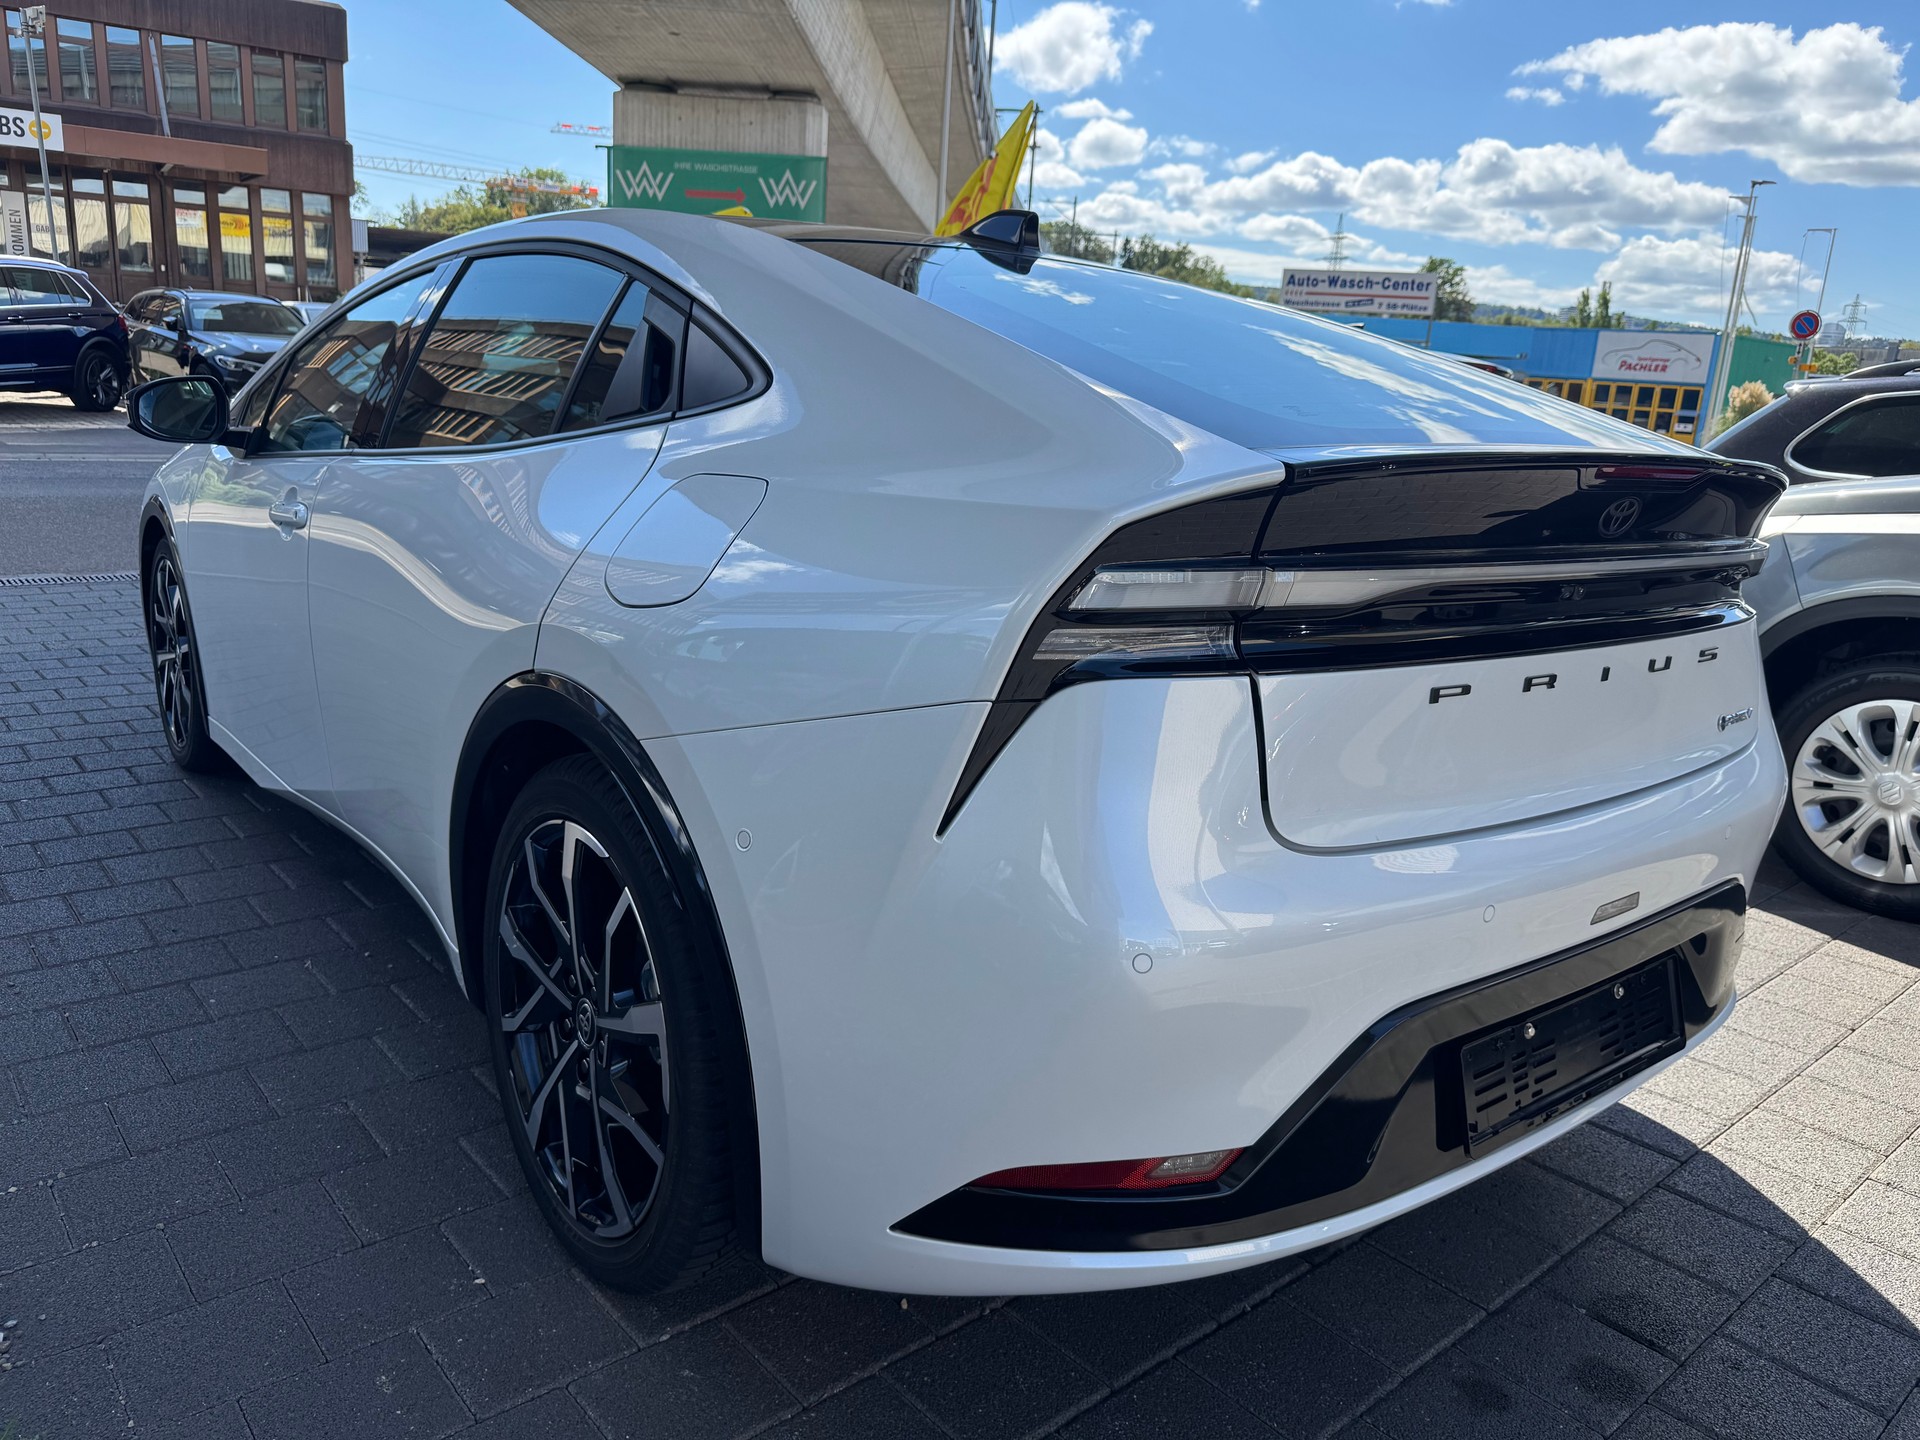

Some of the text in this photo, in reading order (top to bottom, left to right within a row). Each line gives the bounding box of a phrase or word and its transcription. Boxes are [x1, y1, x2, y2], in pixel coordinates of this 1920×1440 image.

[674, 161, 691, 170] IHRE
[1286, 274, 1433, 292] Auto-Wasch-Center
[1618, 360, 1669, 373] PACHLER
[1428, 646, 1720, 705] PRIUS
